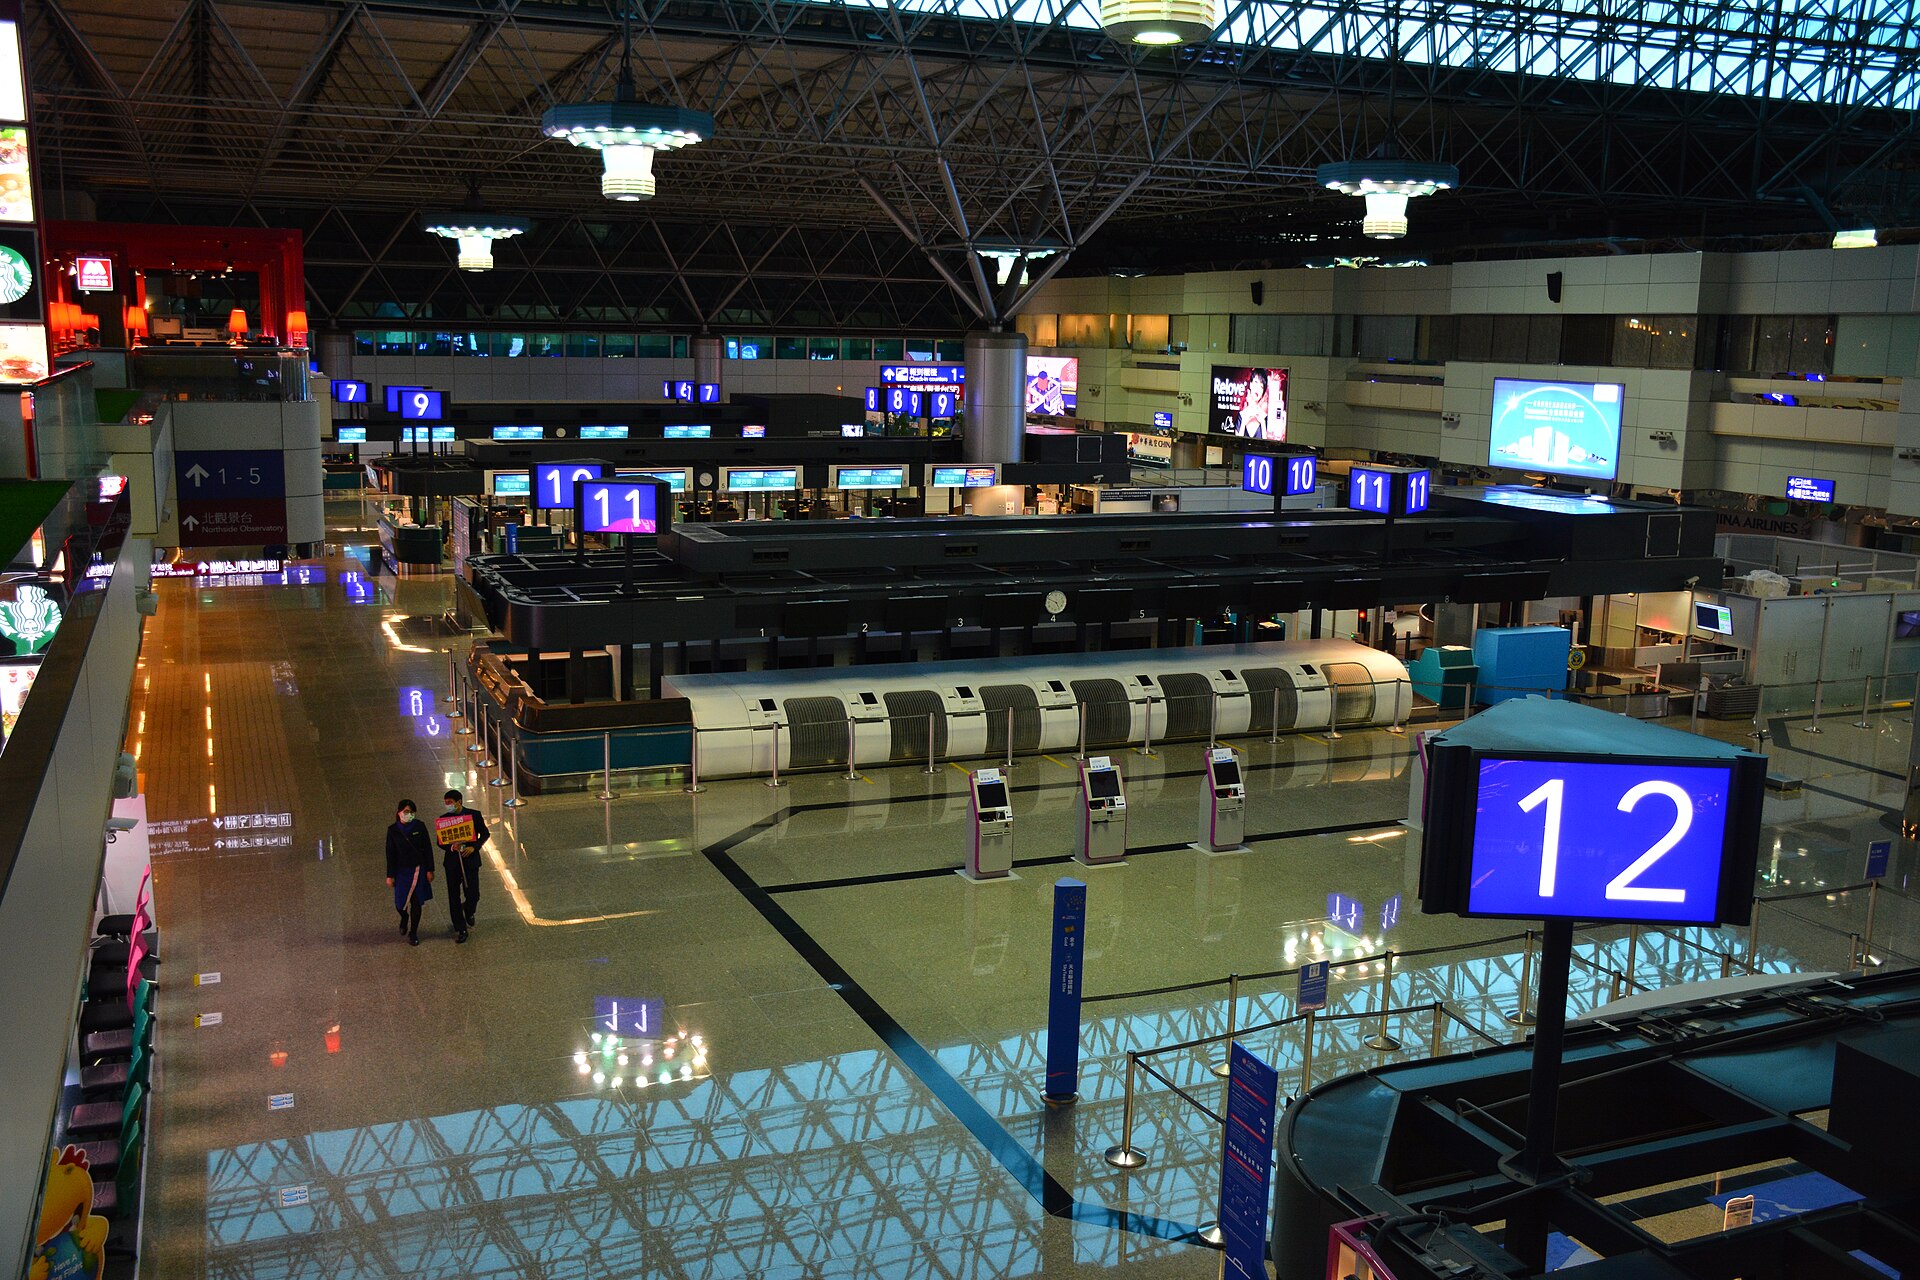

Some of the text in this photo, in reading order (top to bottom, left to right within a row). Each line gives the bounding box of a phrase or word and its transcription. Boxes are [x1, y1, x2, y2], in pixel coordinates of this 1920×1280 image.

[346, 384, 358, 401] 7
[705, 385, 712, 400] 7
[868, 390, 875, 409] 8
[894, 390, 902, 409] 8
[414, 394, 429, 416] 9
[912, 394, 918, 414] 9
[938, 394, 947, 414] 9
[1248, 459, 1271, 494] 10
[1291, 460, 1314, 492] 10
[1356, 470, 1388, 508] 11
[1410, 476, 1427, 509] 11
[594, 488, 642, 528] 11
[240, 525, 284, 534] Observatory
[1743, 518, 1798, 534] AIRLINES
[1139, 610, 1145, 618] 5
[1224, 605, 1231, 614] 6
[1306, 601, 1311, 610] 7
[862, 623, 868, 632] 2
[958, 618, 964, 627] 3
[1050, 614, 1056, 623] 4
[759, 628, 764, 637] 1
[1517, 778, 1694, 904] 12
